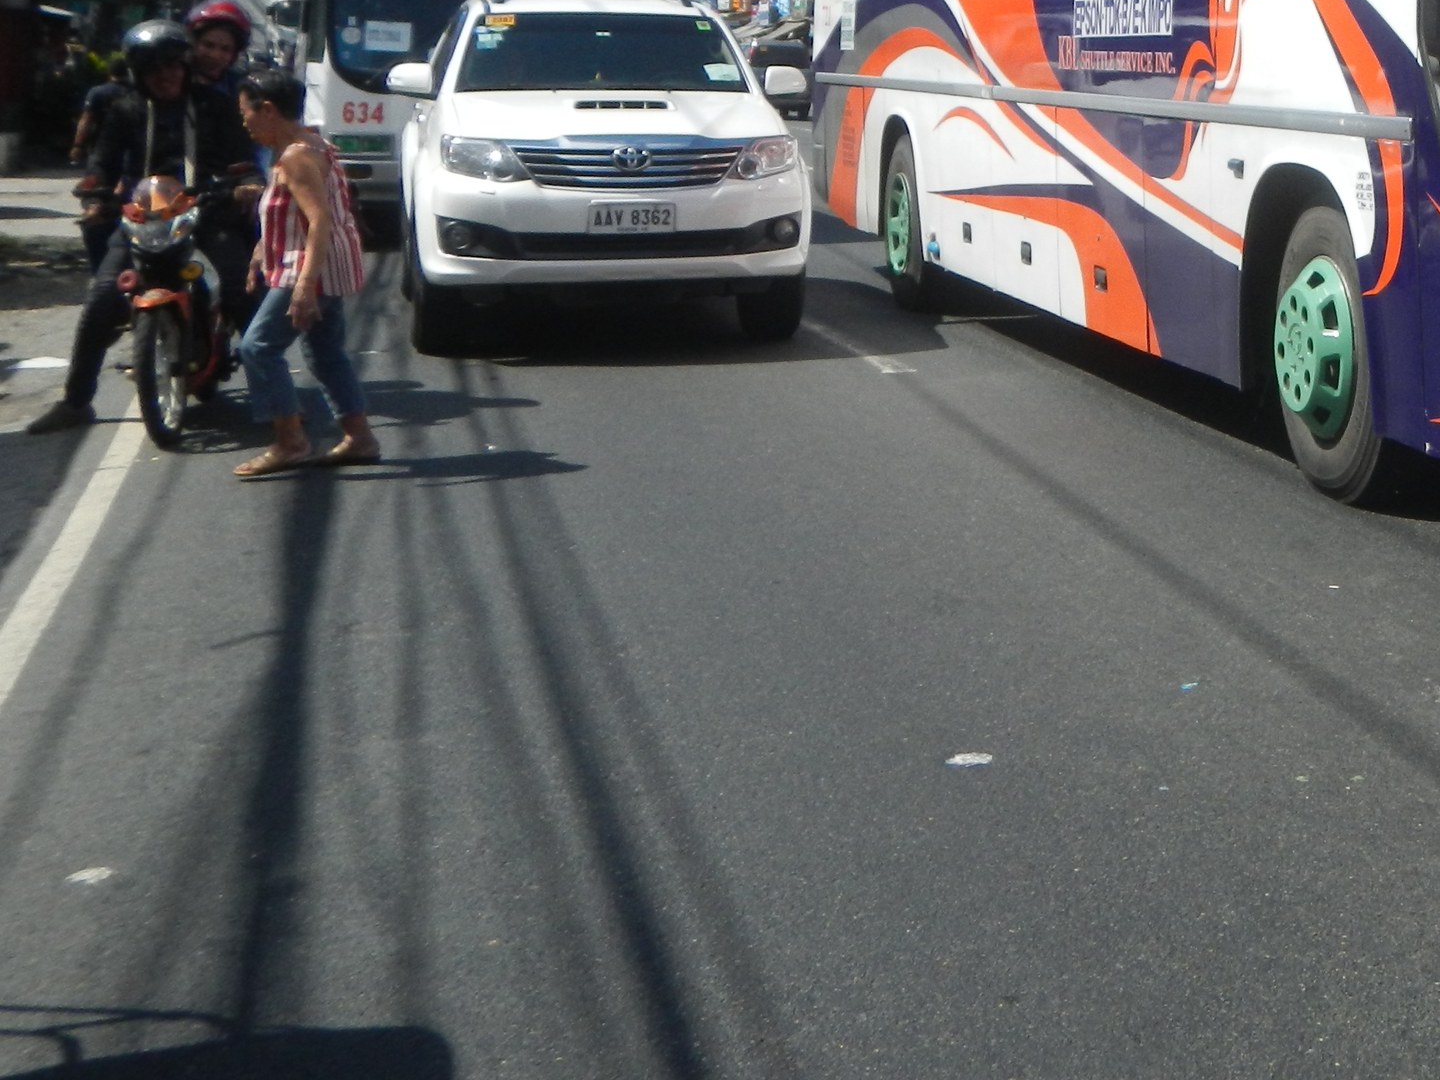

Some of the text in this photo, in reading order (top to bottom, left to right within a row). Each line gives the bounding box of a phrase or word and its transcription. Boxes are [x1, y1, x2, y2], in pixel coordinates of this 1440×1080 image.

[1058, 35, 1176, 74] KBL SHUTTLE SERVICE INC.
[342, 101, 384, 124] 634
[594, 209, 671, 226] AAV 8362
